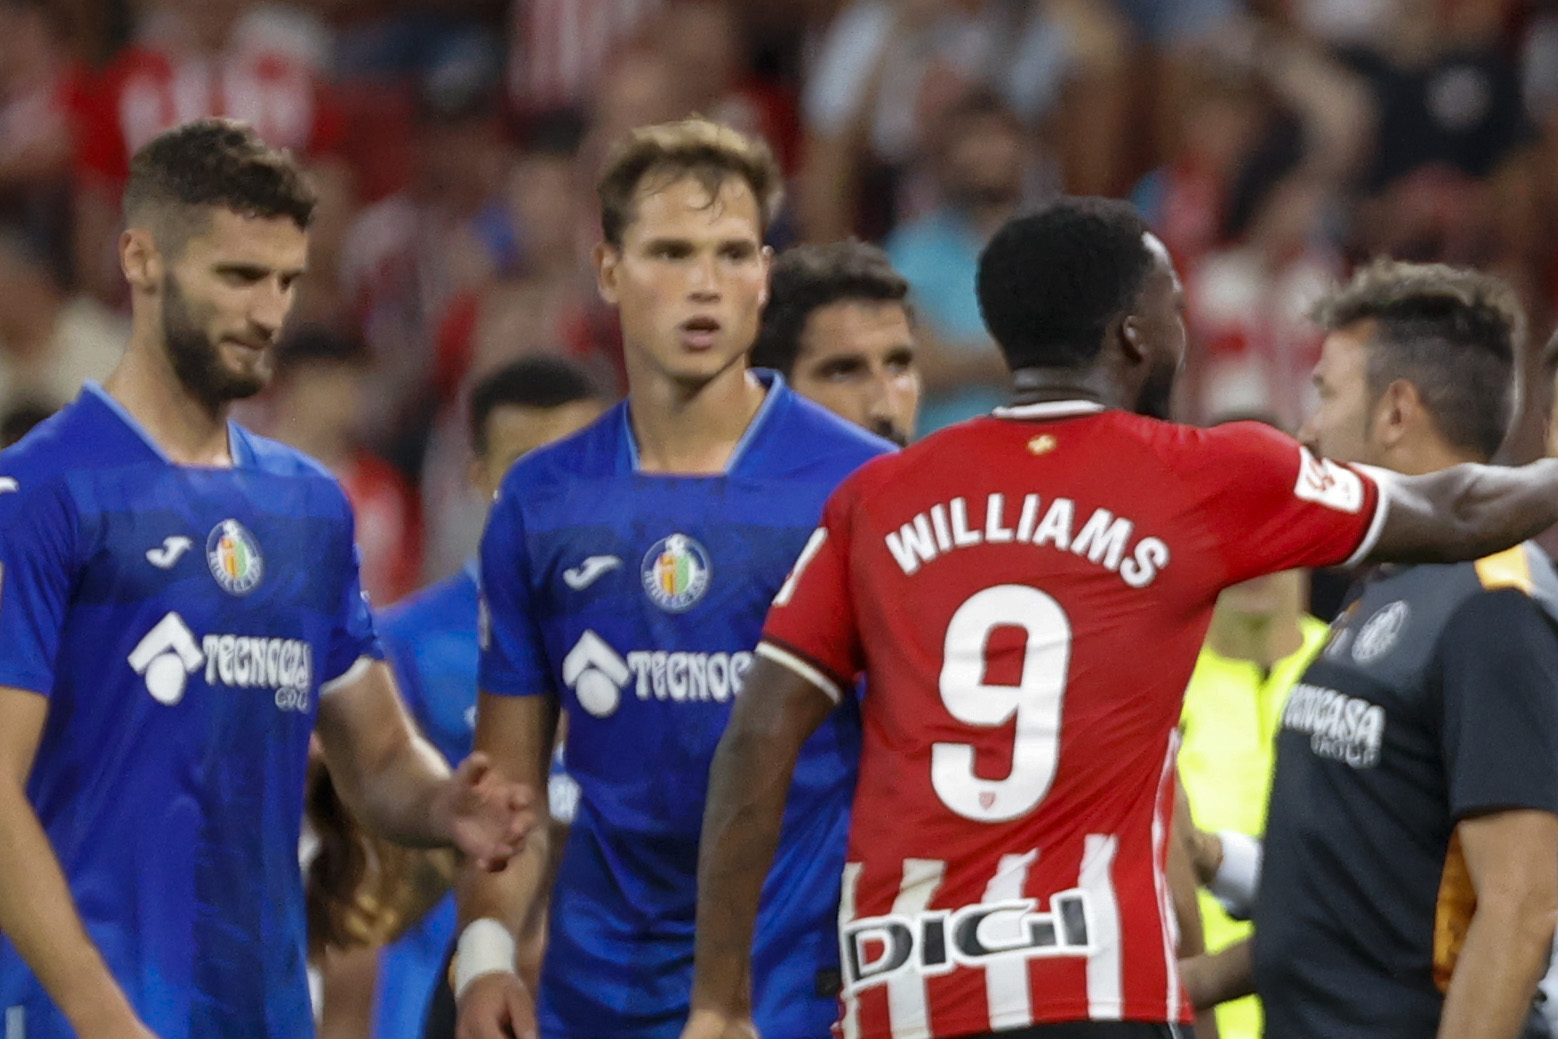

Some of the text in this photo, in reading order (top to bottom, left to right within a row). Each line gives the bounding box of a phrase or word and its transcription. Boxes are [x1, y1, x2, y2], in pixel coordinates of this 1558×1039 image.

[884, 493, 1170, 588] WILLIAMS
[627, 651, 754, 702] TECNOC
[931, 584, 1073, 823] 9
[845, 892, 1092, 985] DIGI
